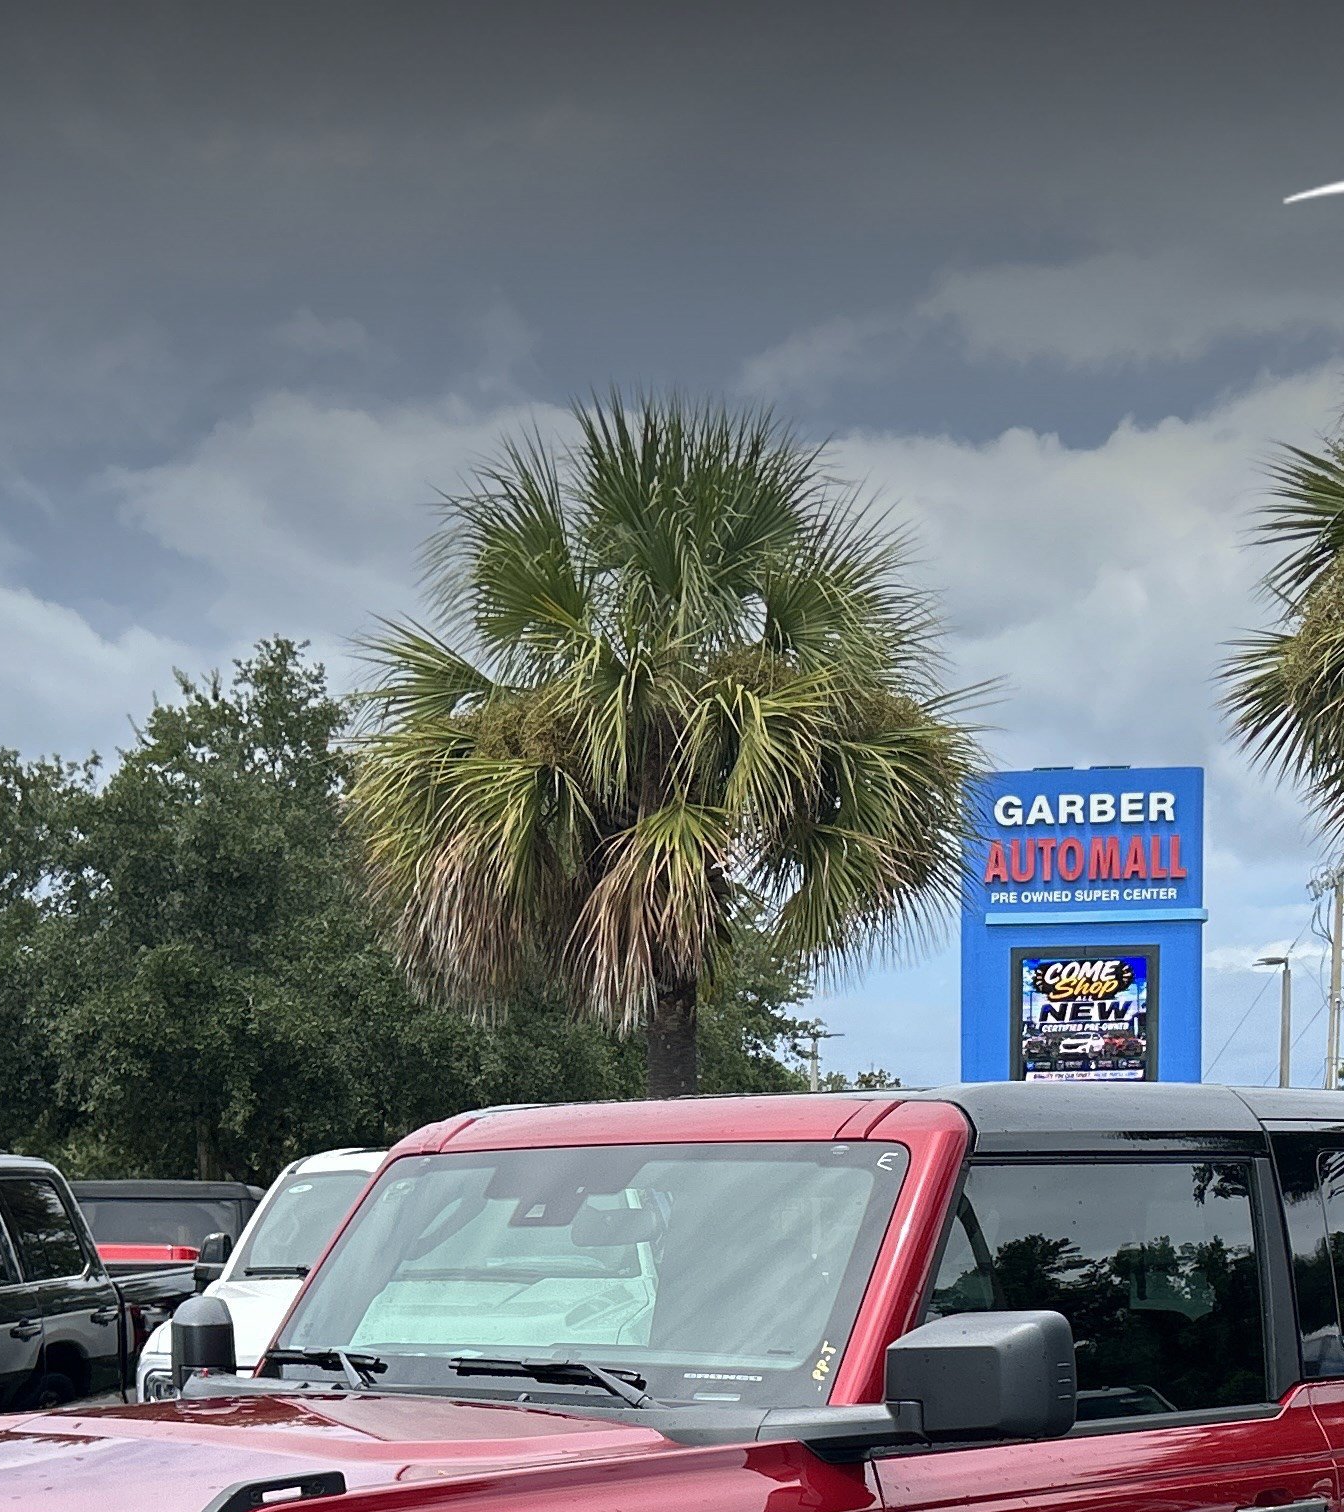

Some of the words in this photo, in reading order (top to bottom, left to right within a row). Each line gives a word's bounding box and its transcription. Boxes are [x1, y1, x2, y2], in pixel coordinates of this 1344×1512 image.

[994, 791, 1176, 827] GARBER
[984, 834, 1188, 884] AUTOMALL
[991, 892, 1017, 904] PRE
[1021, 890, 1072, 903] OWNED
[1074, 889, 1119, 902] SUPER
[1123, 888, 1177, 901] CENTER
[1043, 960, 1121, 985] COME
[1047, 979, 1119, 1000] Shop
[1038, 1001, 1134, 1021] NEW
